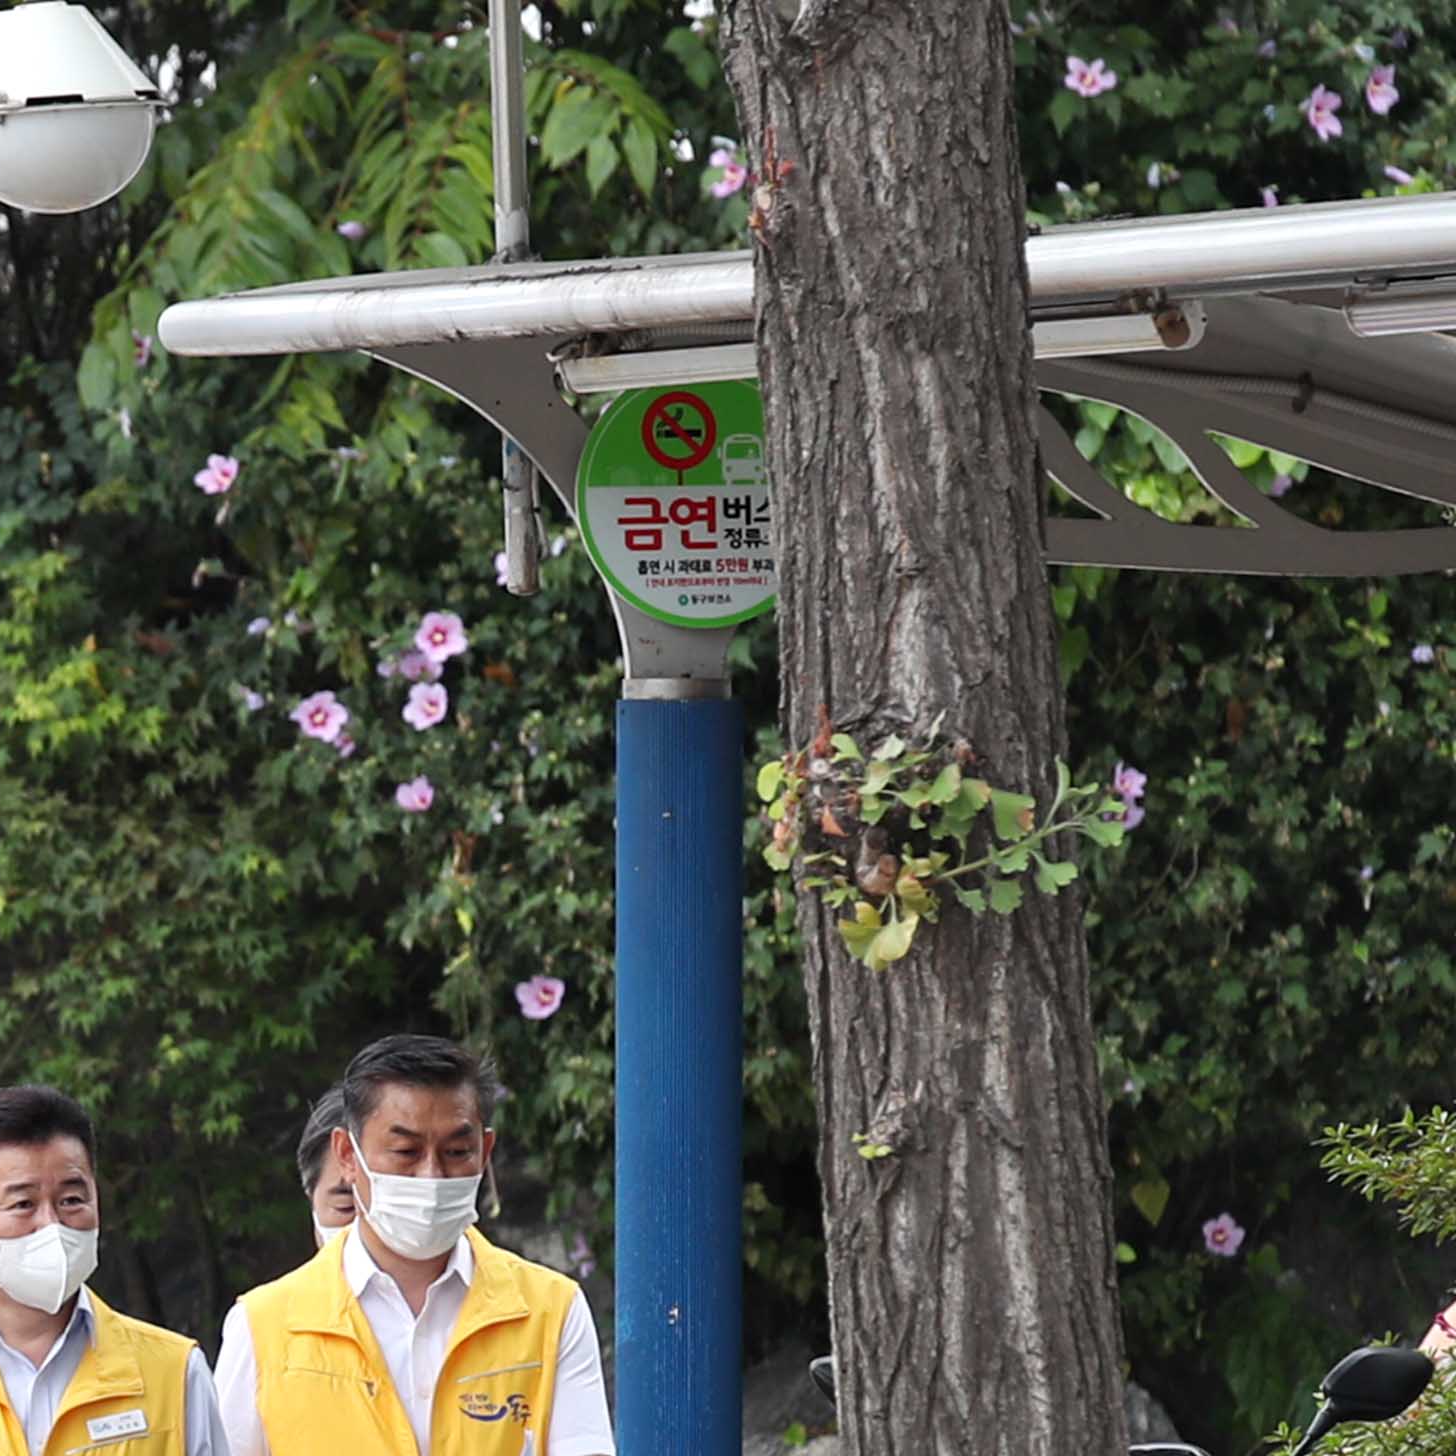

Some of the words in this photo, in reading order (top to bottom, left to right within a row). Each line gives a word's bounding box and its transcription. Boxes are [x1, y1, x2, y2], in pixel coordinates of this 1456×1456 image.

[617, 495, 718, 551] 금연
[664, 560, 675, 574] 시
[716, 558, 748, 573] 5만원
